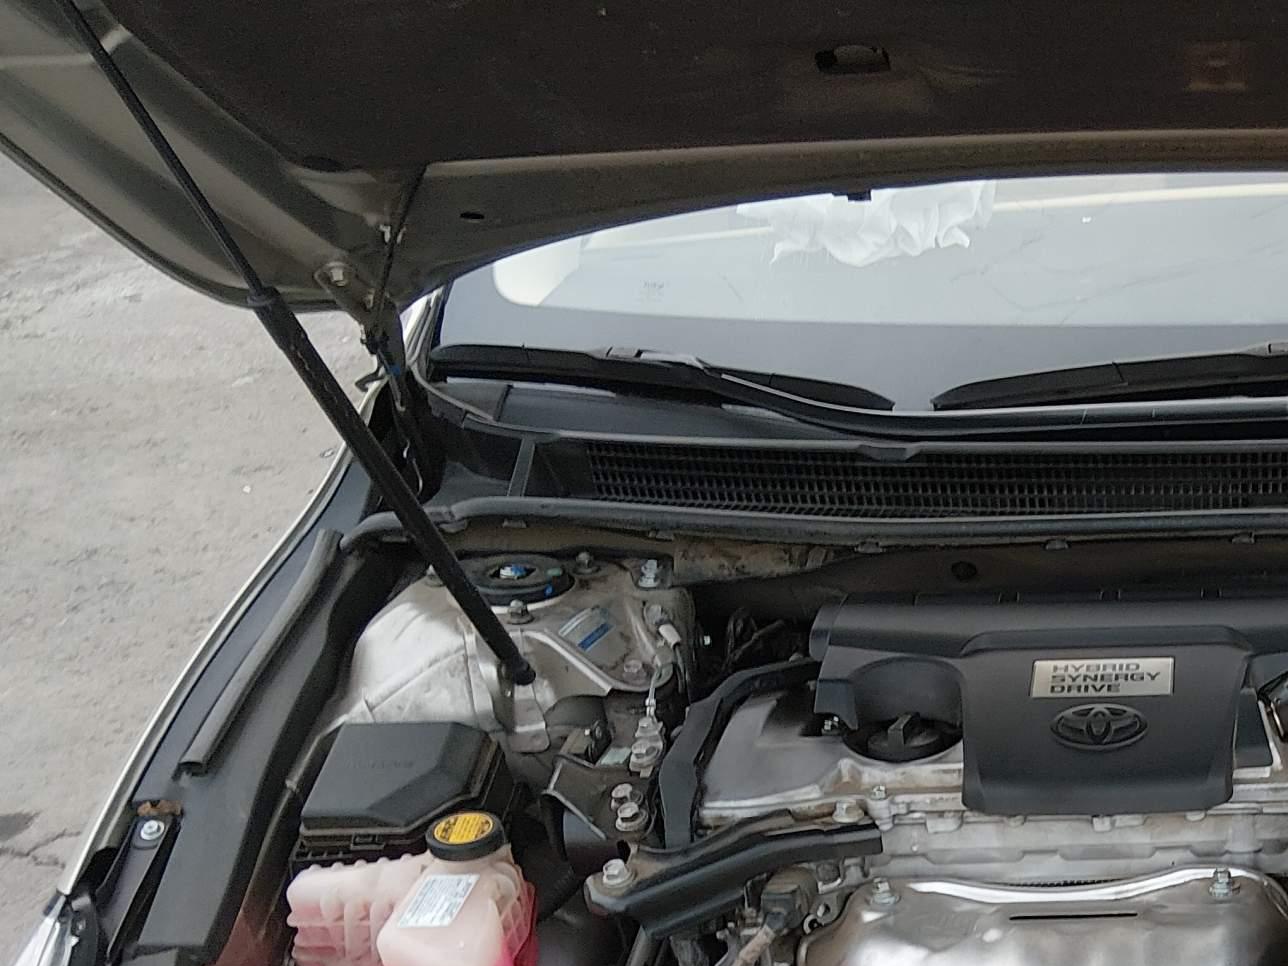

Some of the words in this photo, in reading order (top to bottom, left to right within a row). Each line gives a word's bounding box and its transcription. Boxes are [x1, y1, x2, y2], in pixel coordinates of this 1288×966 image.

[1053, 663, 1140, 673] HYBRID
[1051, 672, 1160, 683] SYNERGY
[1050, 683, 1120, 693] DRIVE
